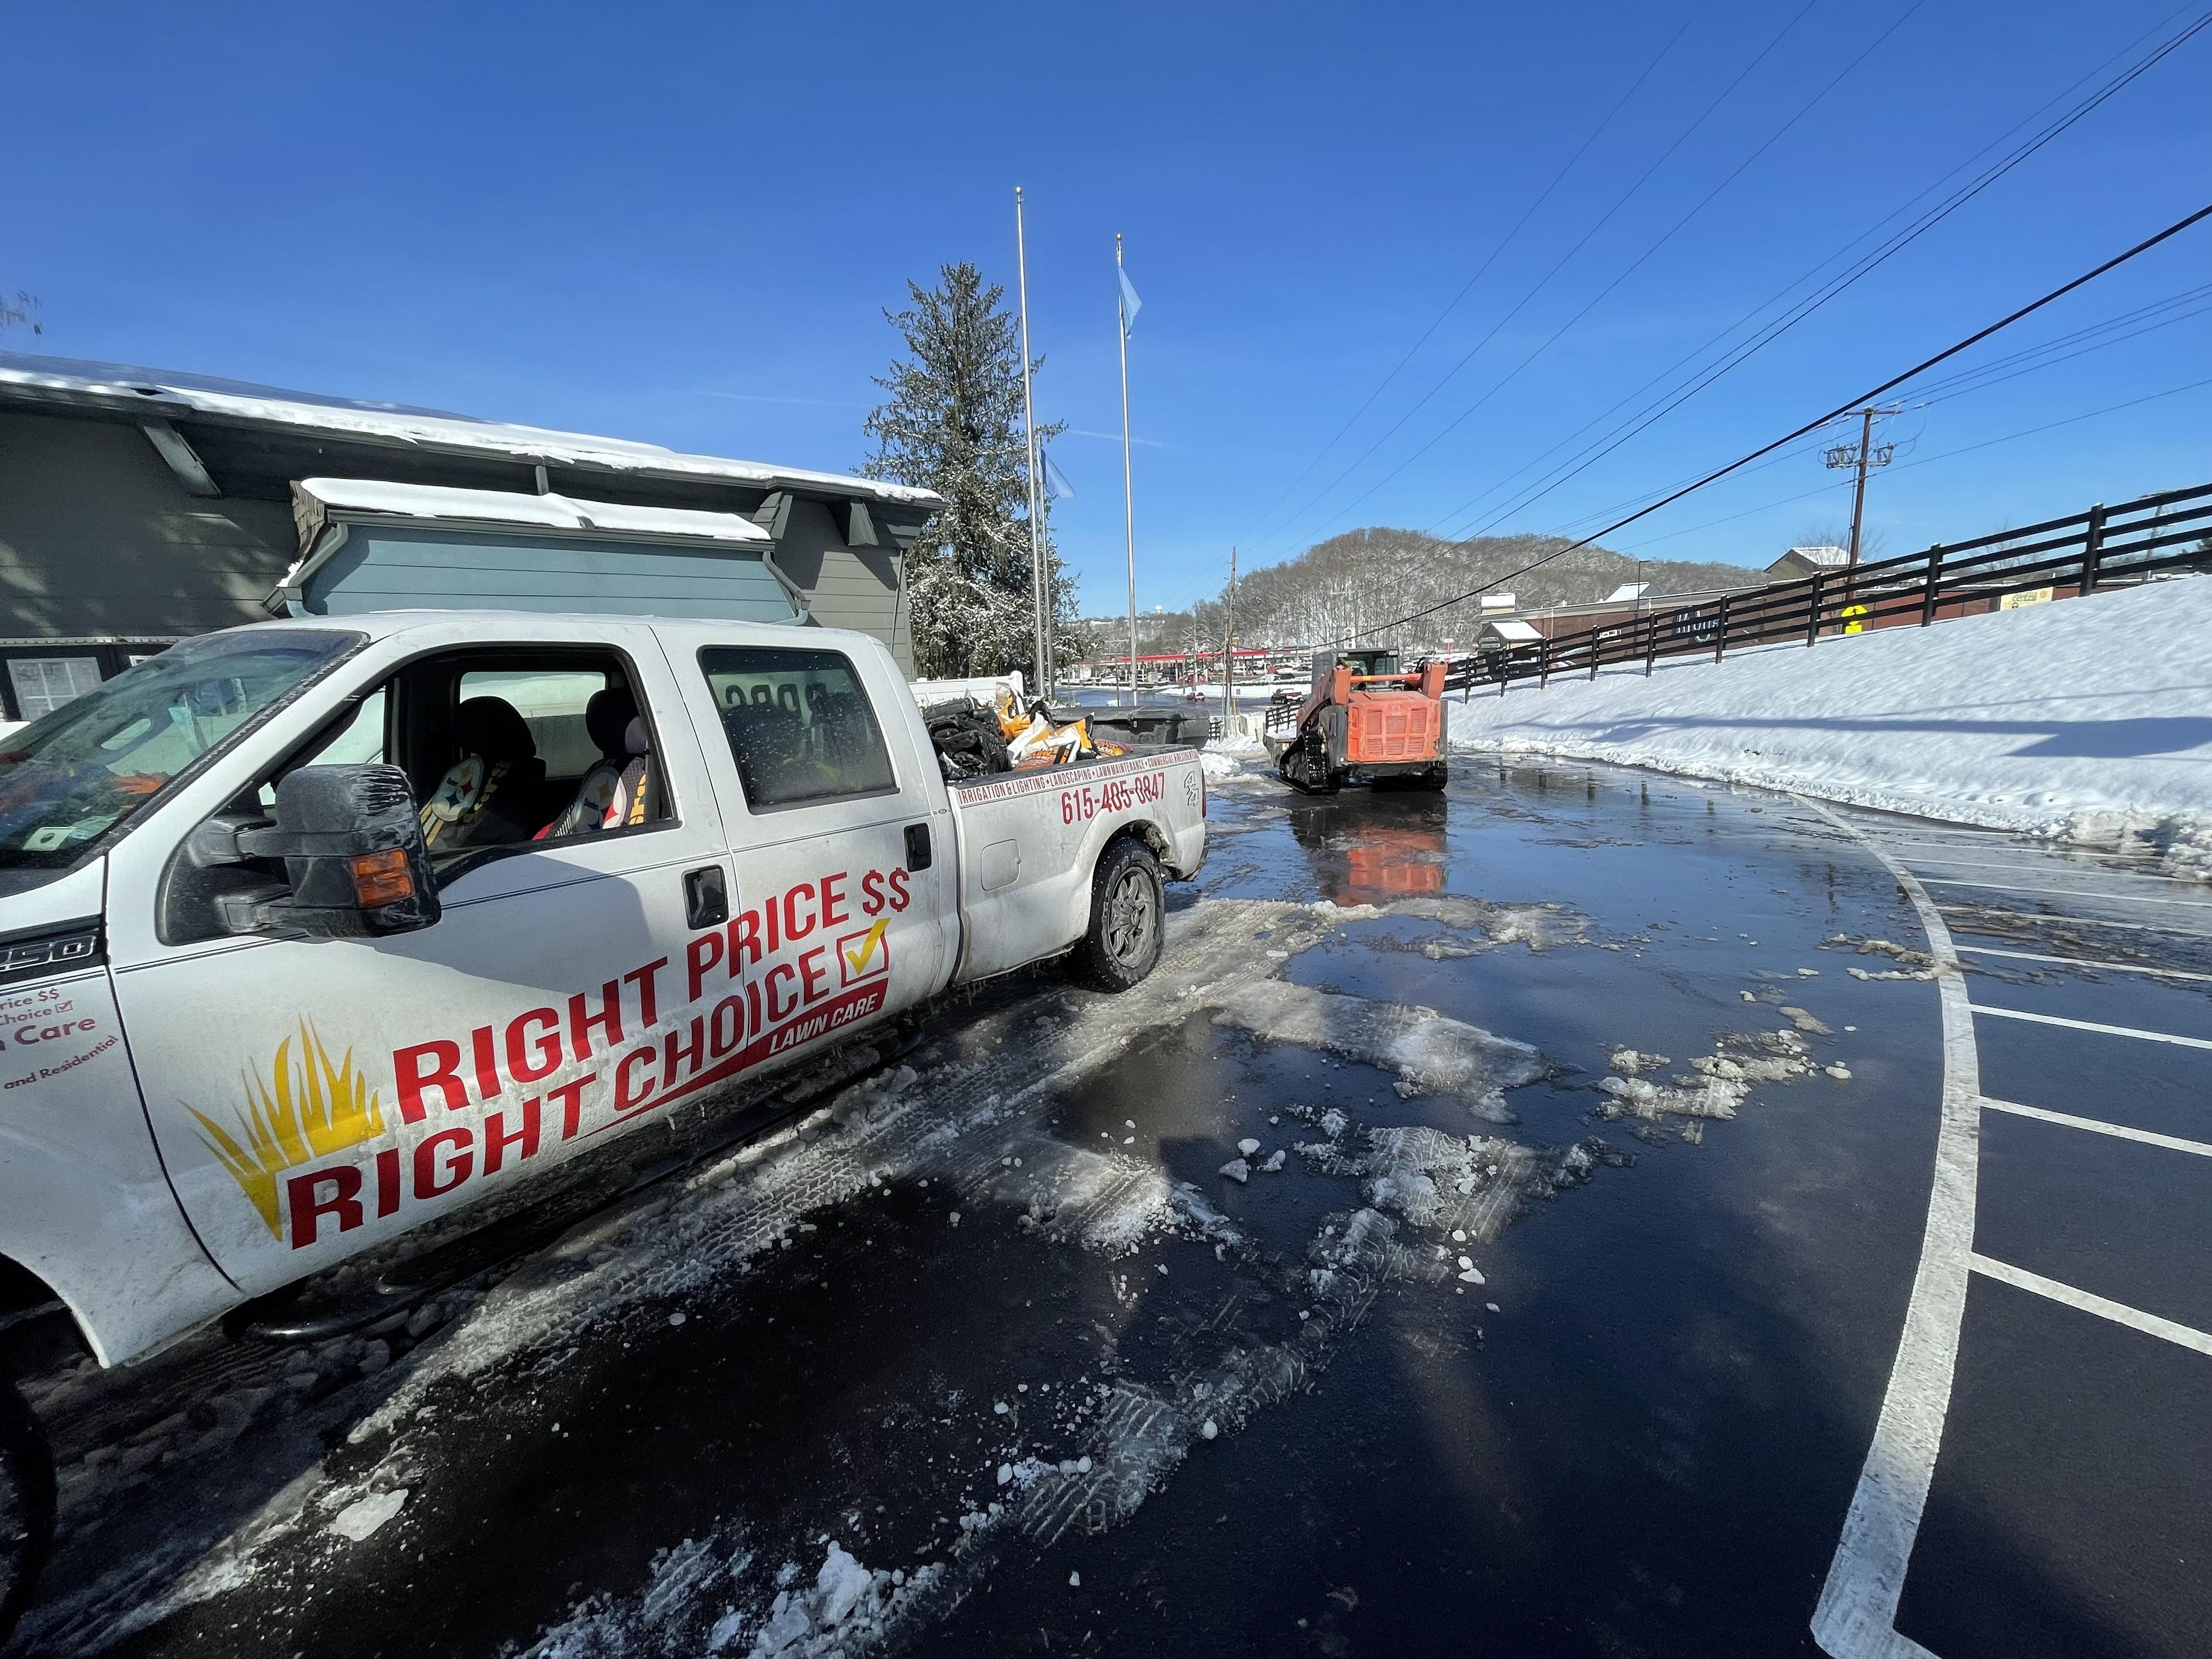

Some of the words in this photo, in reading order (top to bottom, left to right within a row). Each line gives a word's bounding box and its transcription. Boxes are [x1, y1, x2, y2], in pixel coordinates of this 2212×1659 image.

[958, 784, 1006, 804] IRRIGATION
[1007, 783, 1012, 795] &
[1012, 776, 1045, 794] LIGHTING
[1049, 768, 1092, 787] LANDSCAPING
[1096, 766, 1111, 778] LAWN
[1111, 759, 1146, 775] MAINTENANCE
[1061, 772, 1165, 825] 615-405-0847
[0, 935, 97, 972] 50
[37, 988, 59, 1003] $$
[393, 956, 668, 1125] RIGHT
[686, 871, 850, 1003] PRICE
[861, 867, 911, 917] $$
[14, 1018, 96, 1045] Care
[769, 1013, 827, 1055] LAWN
[830, 992, 878, 1028] CARE
[4, 1072, 37, 1089] and
[40, 1035, 119, 1079] Residential
[287, 1072, 596, 1250] RIGHT
[613, 945, 830, 1111] CHOICE
